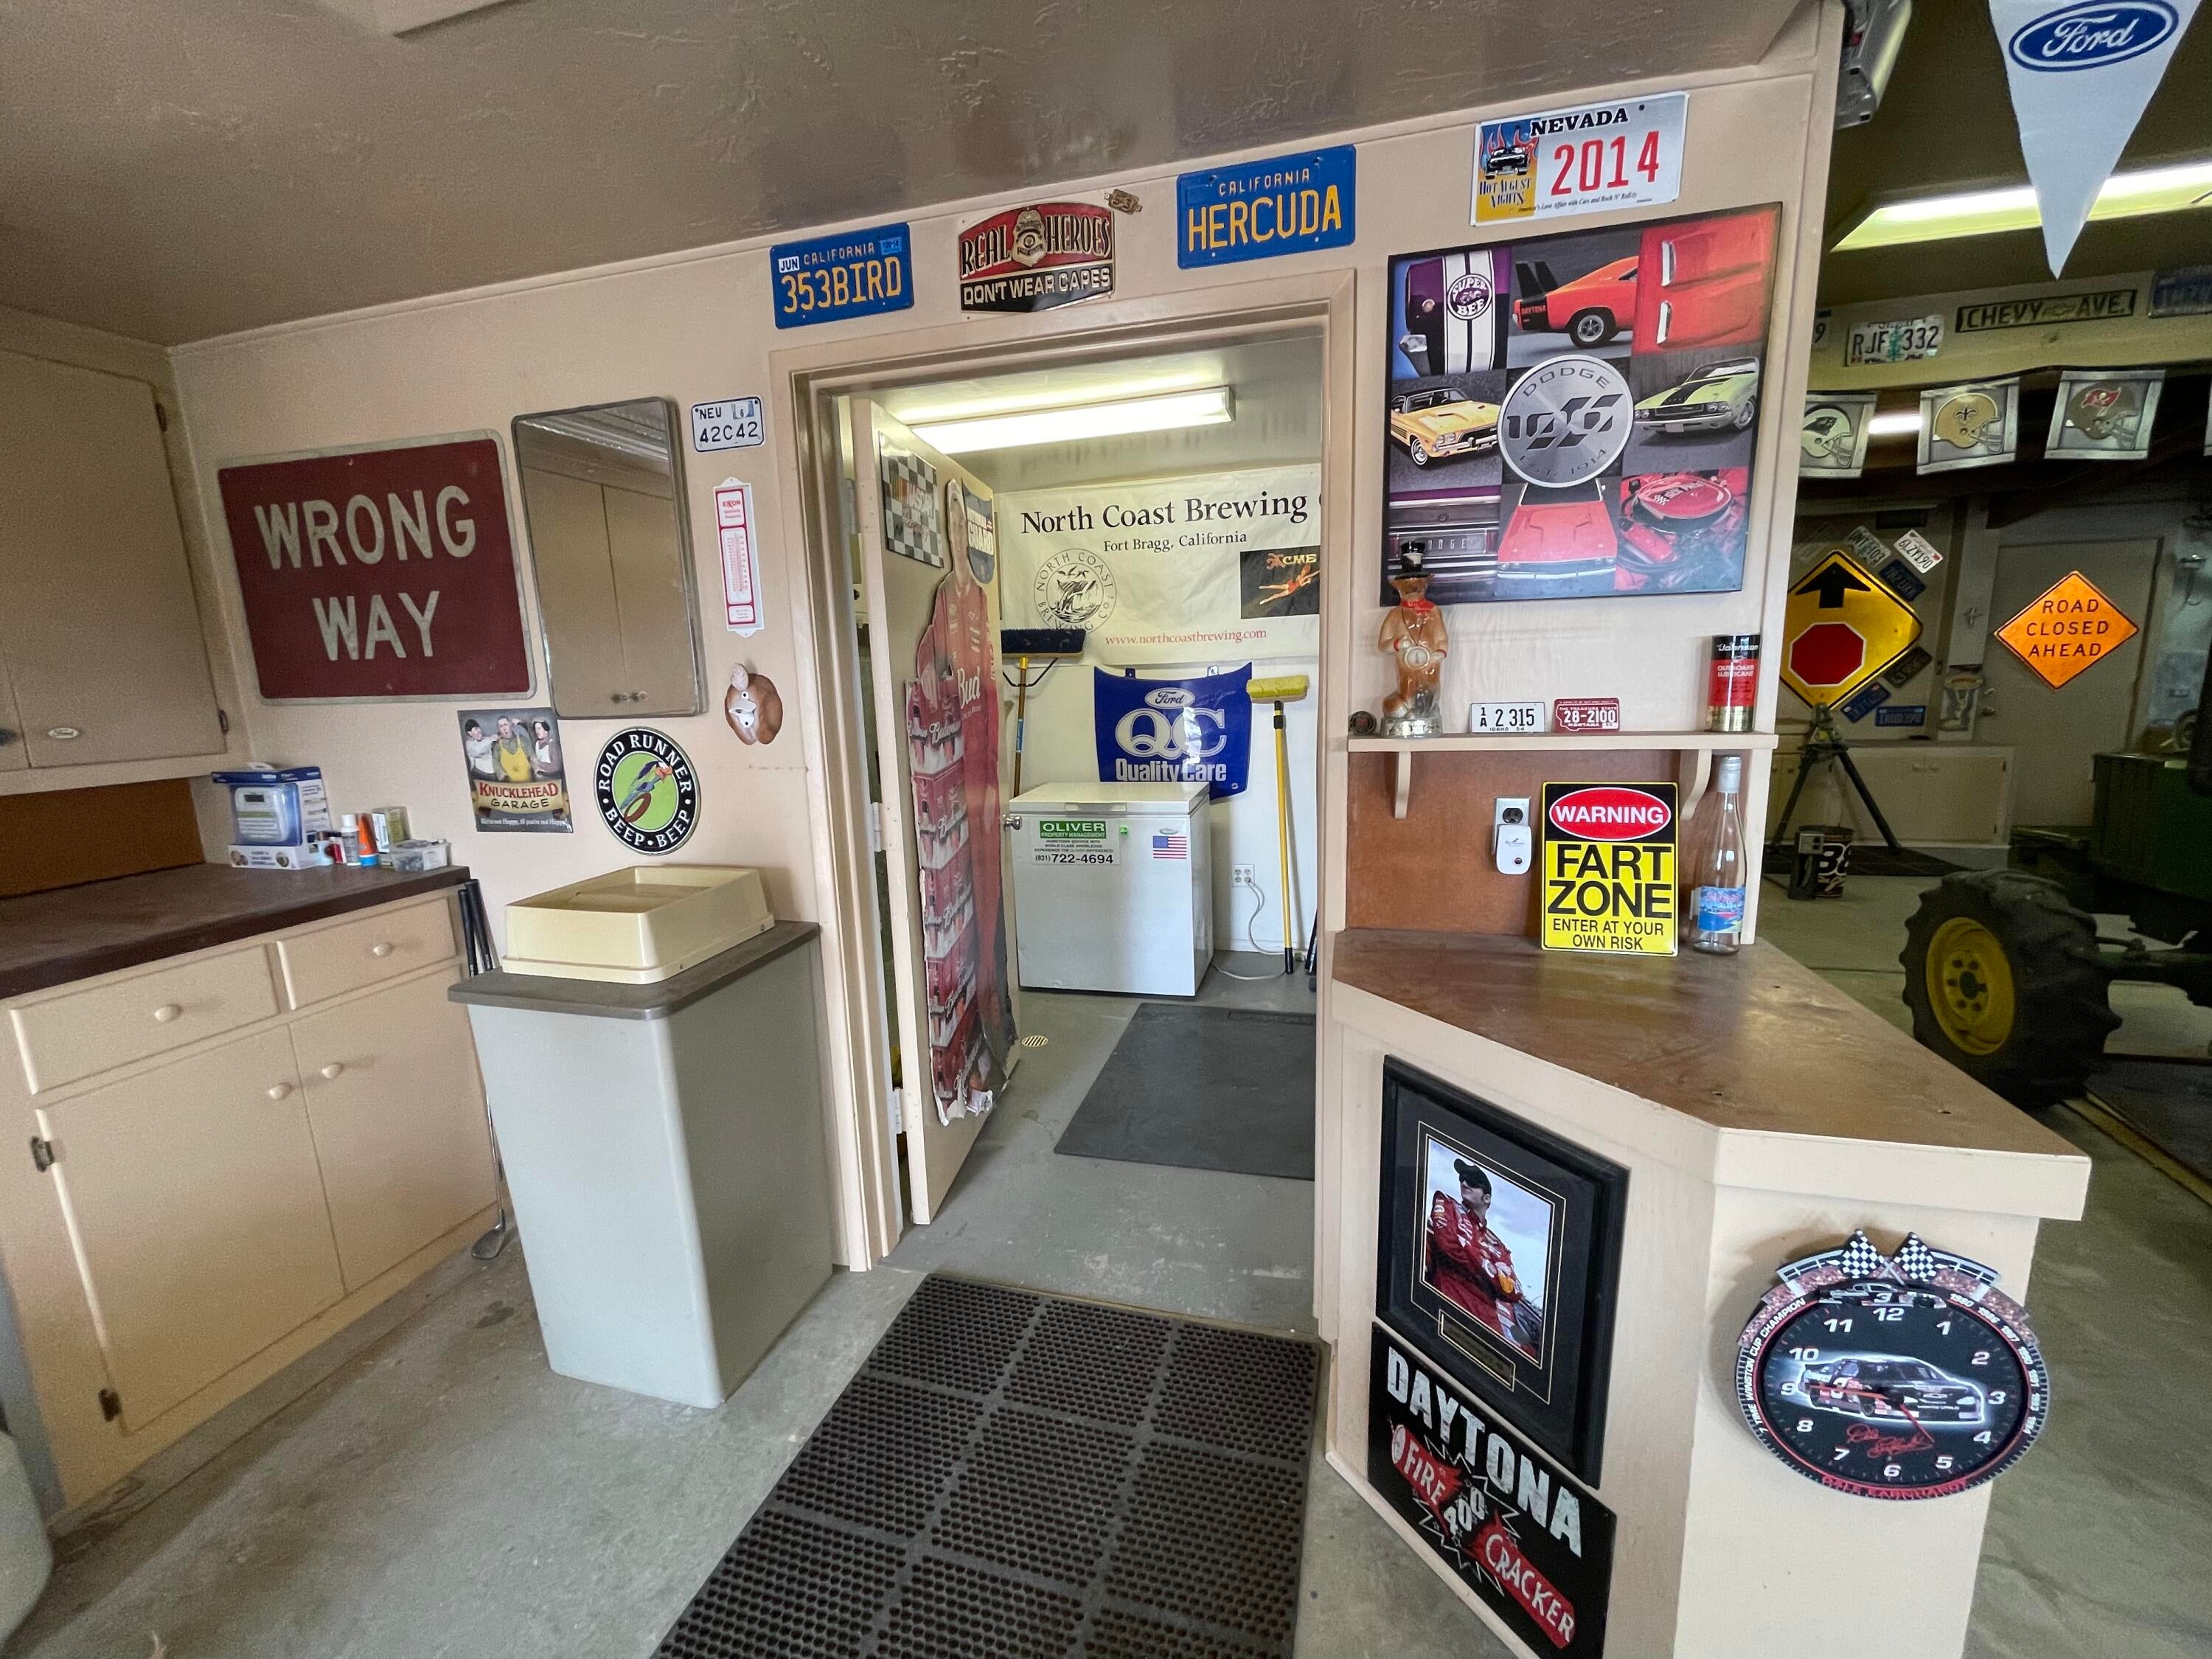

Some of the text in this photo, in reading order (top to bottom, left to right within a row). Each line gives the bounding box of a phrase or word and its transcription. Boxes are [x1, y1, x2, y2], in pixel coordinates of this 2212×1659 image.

[2042, 14, 2135, 58] Ford
[1531, 108, 1628, 136] NEVADA
[1551, 130, 1659, 196] 2014
[1218, 167, 1311, 197] CALIFORNIA
[1189, 184, 1340, 251] HERCUDA
[779, 257, 799, 273] JUN
[803, 242, 875, 266] CALIFORNIA
[961, 214, 1113, 279] REAL HEROES
[781, 256, 902, 314] 353BIRD
[964, 266, 1111, 306] DON'T WEAR CAPES
[1452, 277, 1488, 302] SUPER
[1456, 298, 1485, 316] BEE
[1967, 300, 2044, 329] CHEVY
[1902, 326, 1939, 351] 332
[1523, 367, 1610, 397] DODGE
[700, 421, 759, 442] 42C42
[1571, 448, 1607, 474] 1914
[723, 500, 741, 508] EXXON
[1021, 505, 1094, 534] North
[1102, 501, 1176, 529] Coast
[1184, 490, 1309, 524] Brewing
[254, 484, 477, 571] WRONG
[1103, 531, 1247, 554] Fort Bragg, California
[1036, 552, 1114, 591] NORTH COAST
[1267, 553, 1317, 570] ACME
[1038, 601, 1093, 631] BREWG
[2042, 599, 2100, 614] ROAD
[313, 589, 440, 662] WAY
[1105, 628, 1267, 644] www.northcoastbrewing.com
[2026, 620, 2110, 637] CLOSED
[2028, 642, 2102, 658] AHEAD
[957, 666, 981, 710] Bud
[1155, 689, 1184, 706] Ford
[1480, 718, 1487, 727] A
[1481, 707, 1486, 716] 1
[1495, 709, 1534, 726] 2 315
[1564, 710, 1616, 723] 28-2100
[1115, 708, 1227, 760] QC
[598, 734, 692, 793] ROAD RUNNER
[1116, 758, 1227, 782] Quality Care
[479, 782, 558, 799] KNUCKLEHEAD
[490, 798, 549, 809] GARAGE
[1555, 806, 1664, 824] WARNING
[605, 807, 691, 848] BEEP BEEP
[1042, 823, 1105, 832] OLIVER
[1051, 854, 1113, 864] 722-4694
[1557, 844, 1672, 881] FART
[1548, 880, 1672, 918] ZONE
[1553, 918, 1664, 936] ENTER AT YOUR
[1572, 934, 1644, 950] OWN RISK
[1760, 1297, 1806, 1338] CHAMPION
[1872, 1307, 1905, 1321] 12
[1823, 1319, 1853, 1333] 11
[1936, 1321, 1951, 1335] 1
[1749, 1338, 1763, 1357] CUP
[1789, 1348, 1820, 1362] 10
[1971, 1352, 1990, 1365] 2
[1744, 1357, 1755, 1401] WINSTON
[1781, 1382, 1798, 1396] 9
[1988, 1391, 2006, 1405] 3
[1747, 1403, 1763, 1425] TIME
[1796, 1419, 1814, 1433] 8
[1973, 1430, 1992, 1444] 4
[1387, 1346, 1583, 1559] DAYTONA
[1834, 1448, 1850, 1461] 7
[1935, 1455, 1953, 1469] 5
[1402, 1444, 1446, 1506] FIRE
[1883, 1464, 1902, 1477] 6
[1443, 1485, 1486, 1536] 400
[1485, 1534, 1576, 1645] CRACKER
